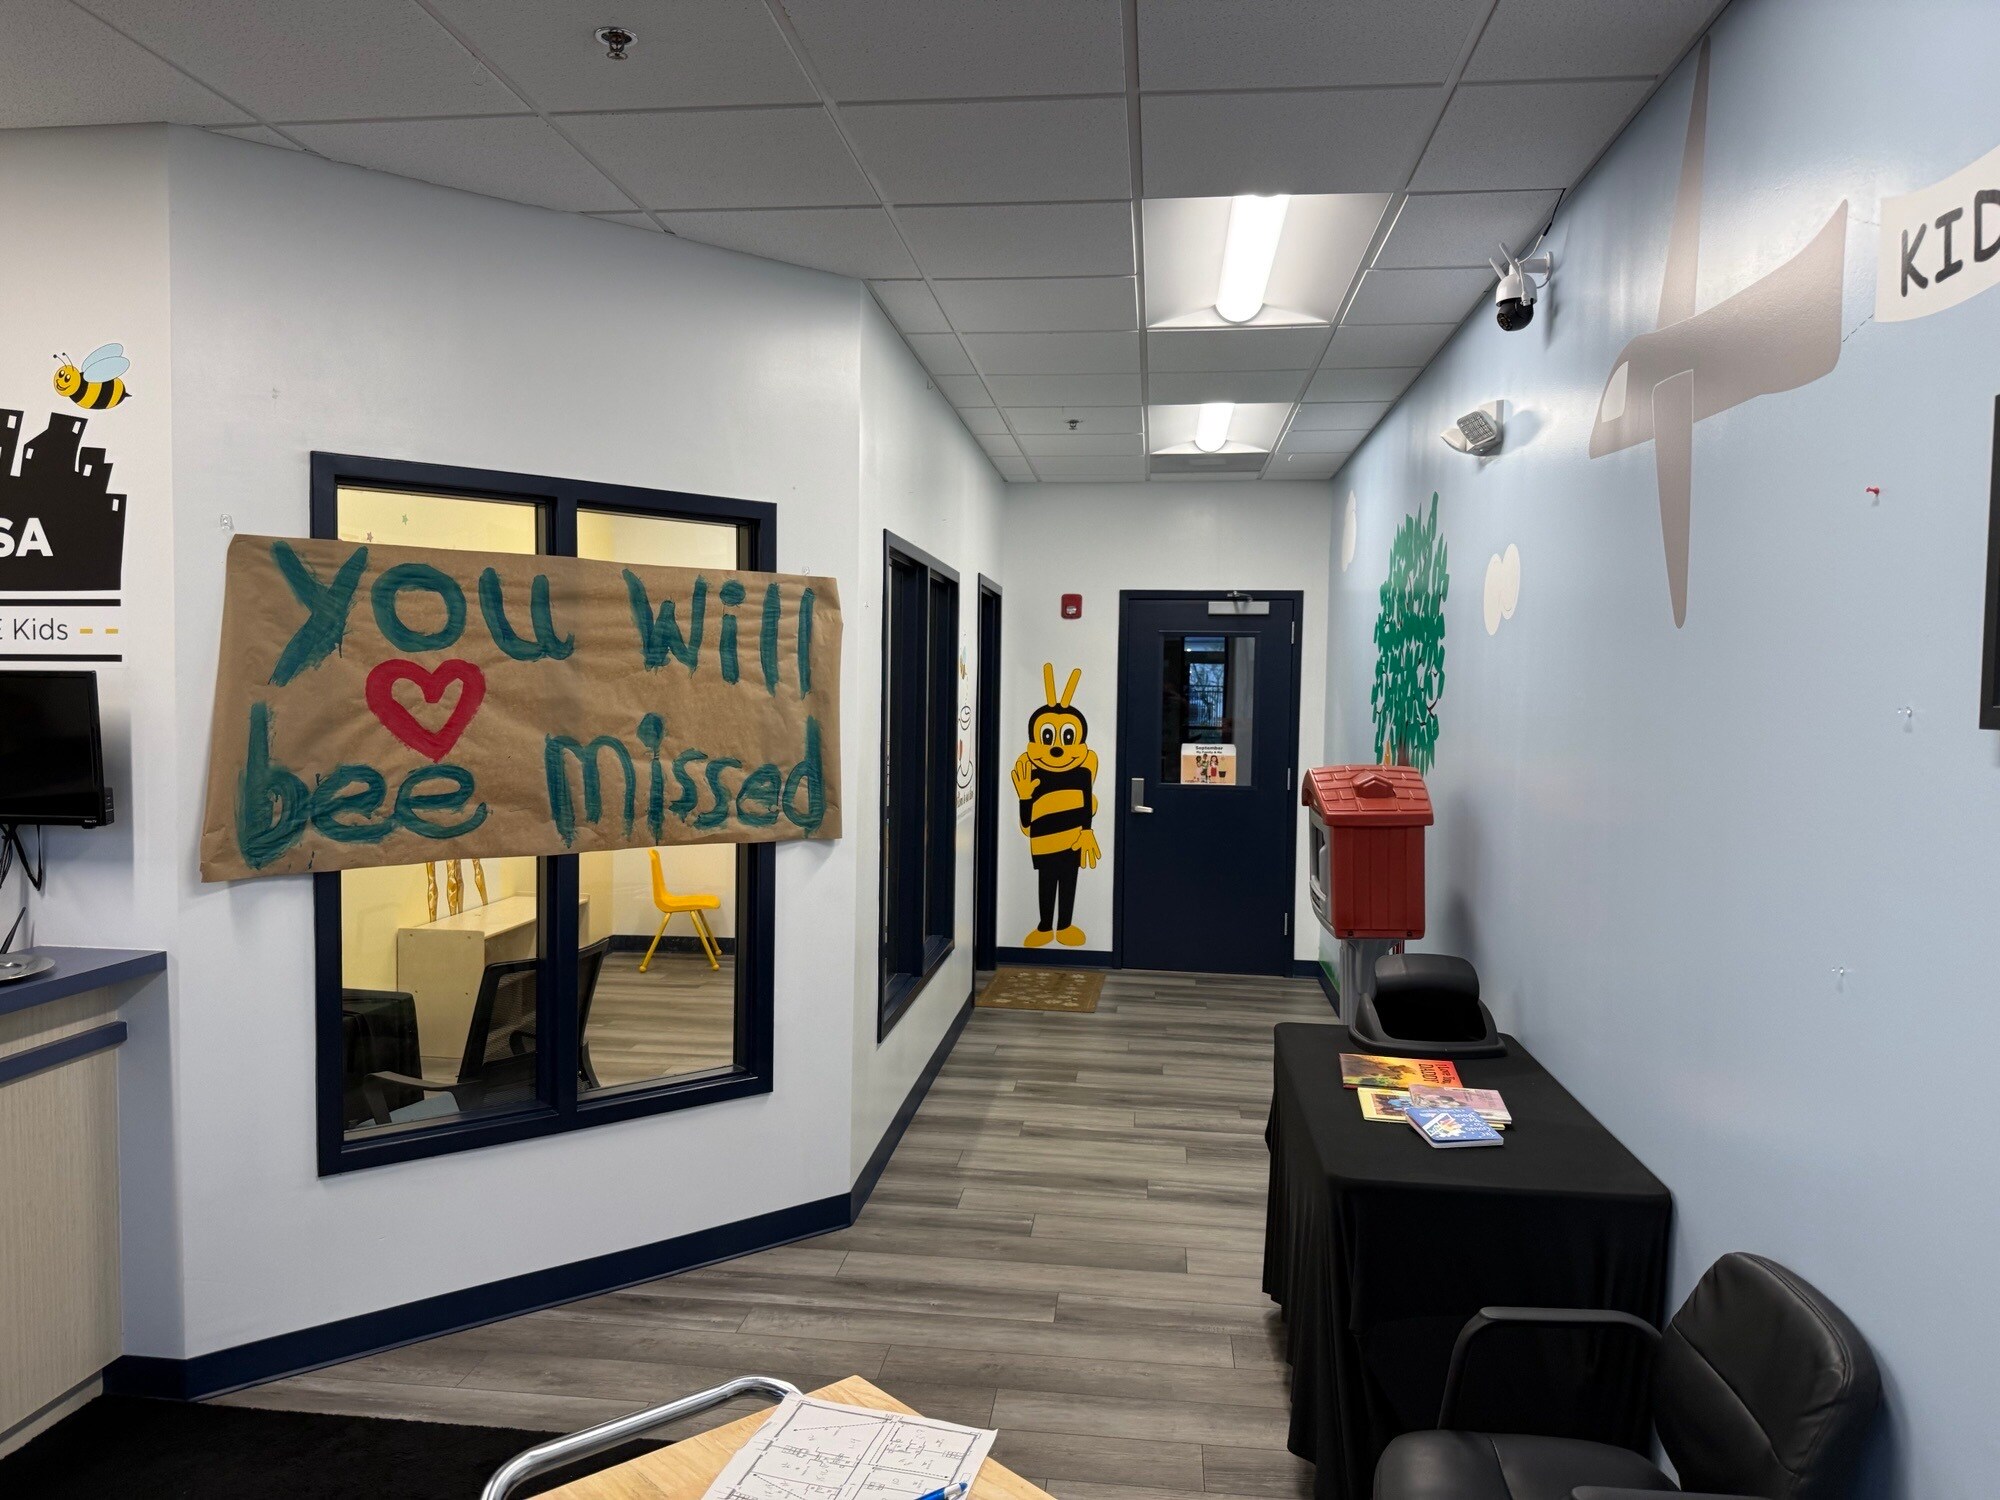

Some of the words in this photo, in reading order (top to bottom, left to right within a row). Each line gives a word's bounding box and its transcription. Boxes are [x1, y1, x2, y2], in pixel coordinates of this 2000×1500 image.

[13, 618, 68, 640] Kids
[237, 702, 488, 868] bee
[545, 712, 825, 848] missed
[1419, 1063, 1439, 1083] DADDY
